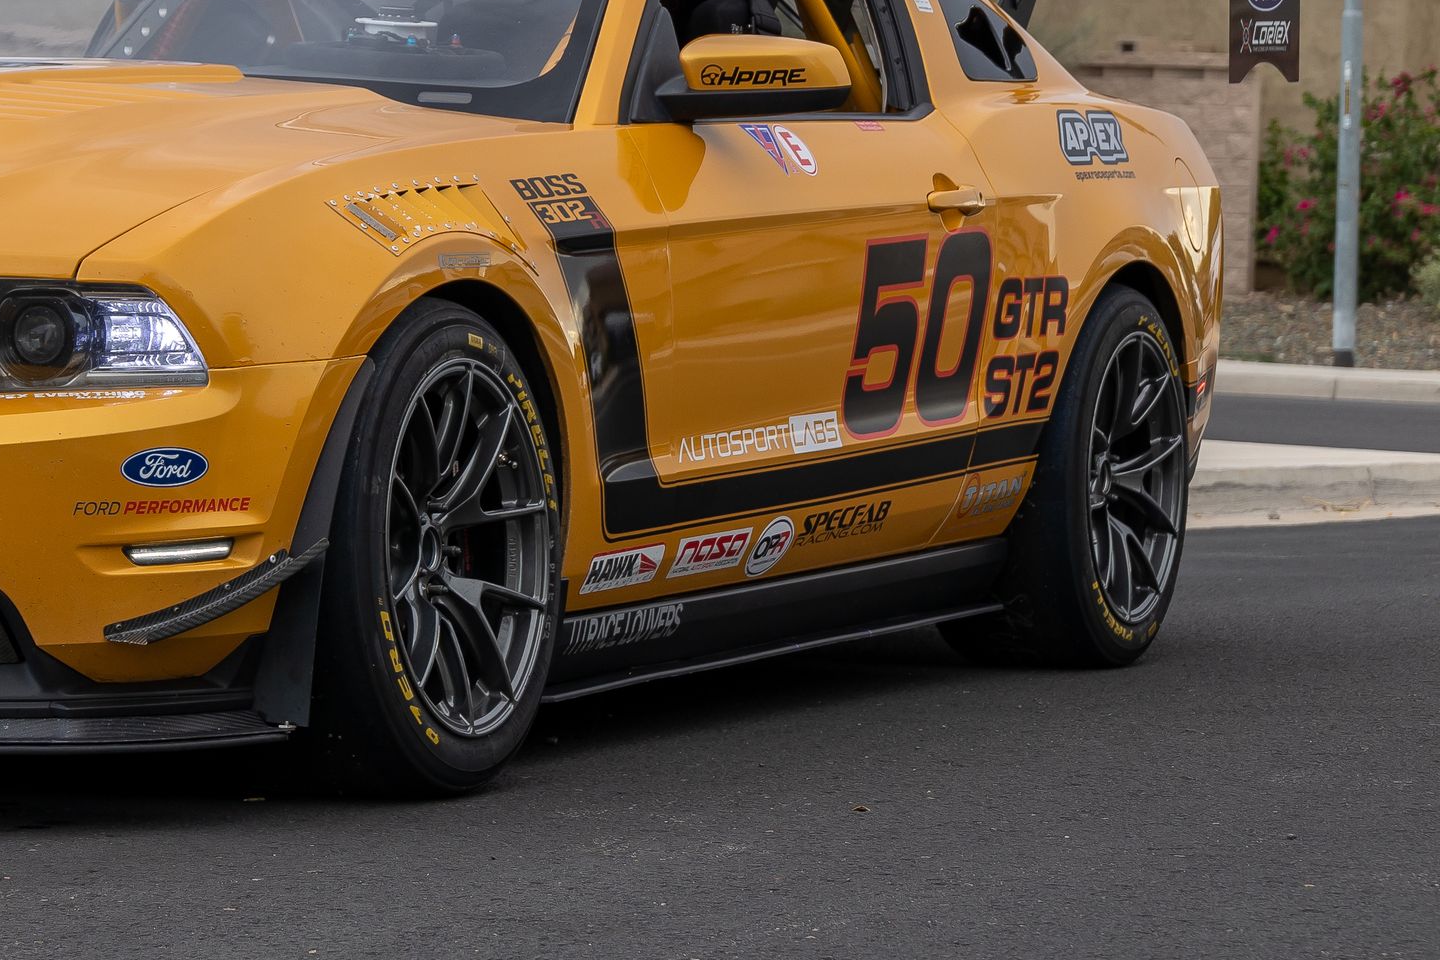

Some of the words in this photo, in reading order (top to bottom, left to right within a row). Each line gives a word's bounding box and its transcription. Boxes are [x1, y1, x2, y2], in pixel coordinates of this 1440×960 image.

[778, 131, 813, 166] E
[509, 173, 588, 201] BOSS
[992, 275, 1070, 341] GTR
[840, 226, 995, 442] 50
[984, 350, 1060, 419] ST2
[139, 453, 193, 480] Ford
[73, 501, 122, 517] FORD
[123, 496, 251, 516] PERFORMANCE
[961, 475, 1024, 510] TITAN
[791, 521, 884, 550] RACING.COM
[797, 500, 892, 538] SPECFAB
[585, 552, 641, 586] HAWK
